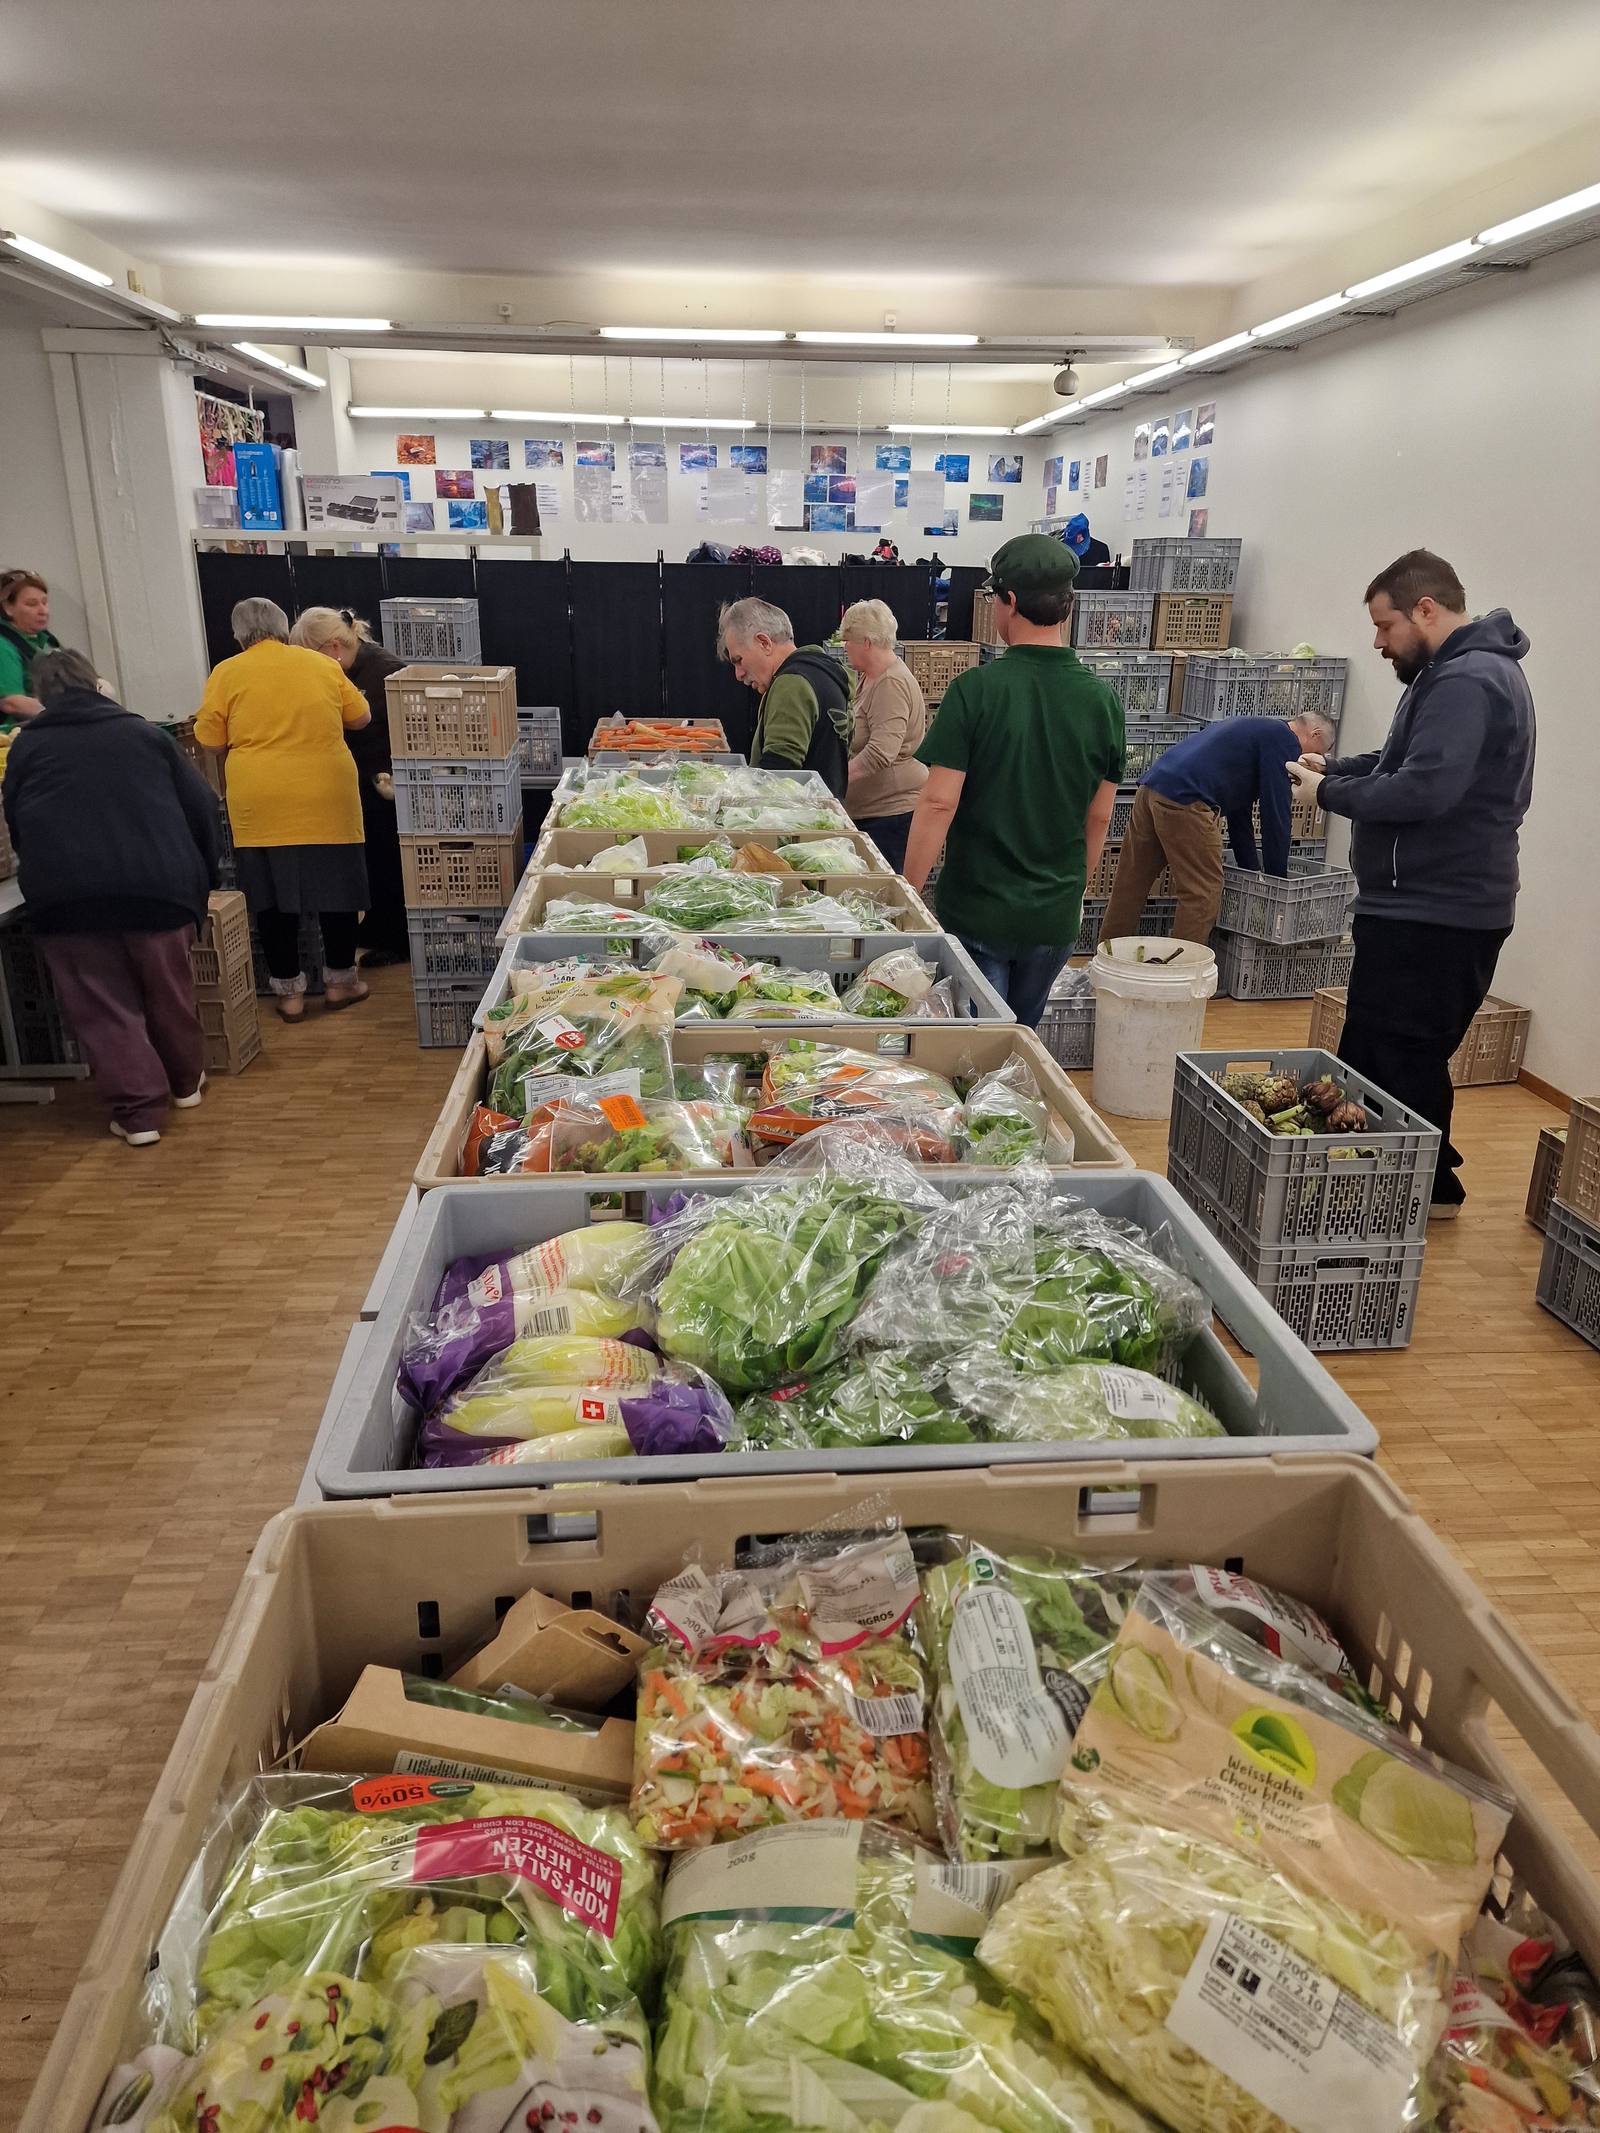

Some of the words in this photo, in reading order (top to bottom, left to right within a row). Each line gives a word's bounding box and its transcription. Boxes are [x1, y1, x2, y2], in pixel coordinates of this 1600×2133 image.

[1408, 1196, 1421, 1226] coop
[1395, 1302, 1407, 1329] coop
[1219, 1768, 1257, 1795] Chou
[1228, 1754, 1304, 1801] Weisskabis
[361, 1786, 424, 1808] 50%
[472, 1819, 502, 1829] CUORI
[391, 1860, 400, 1872] 2
[493, 1836, 572, 1874] HERZEN
[577, 1866, 612, 1900] MIT
[1283, 1957, 1309, 1982] 200
[1294, 1984, 1324, 2012] 2.10
